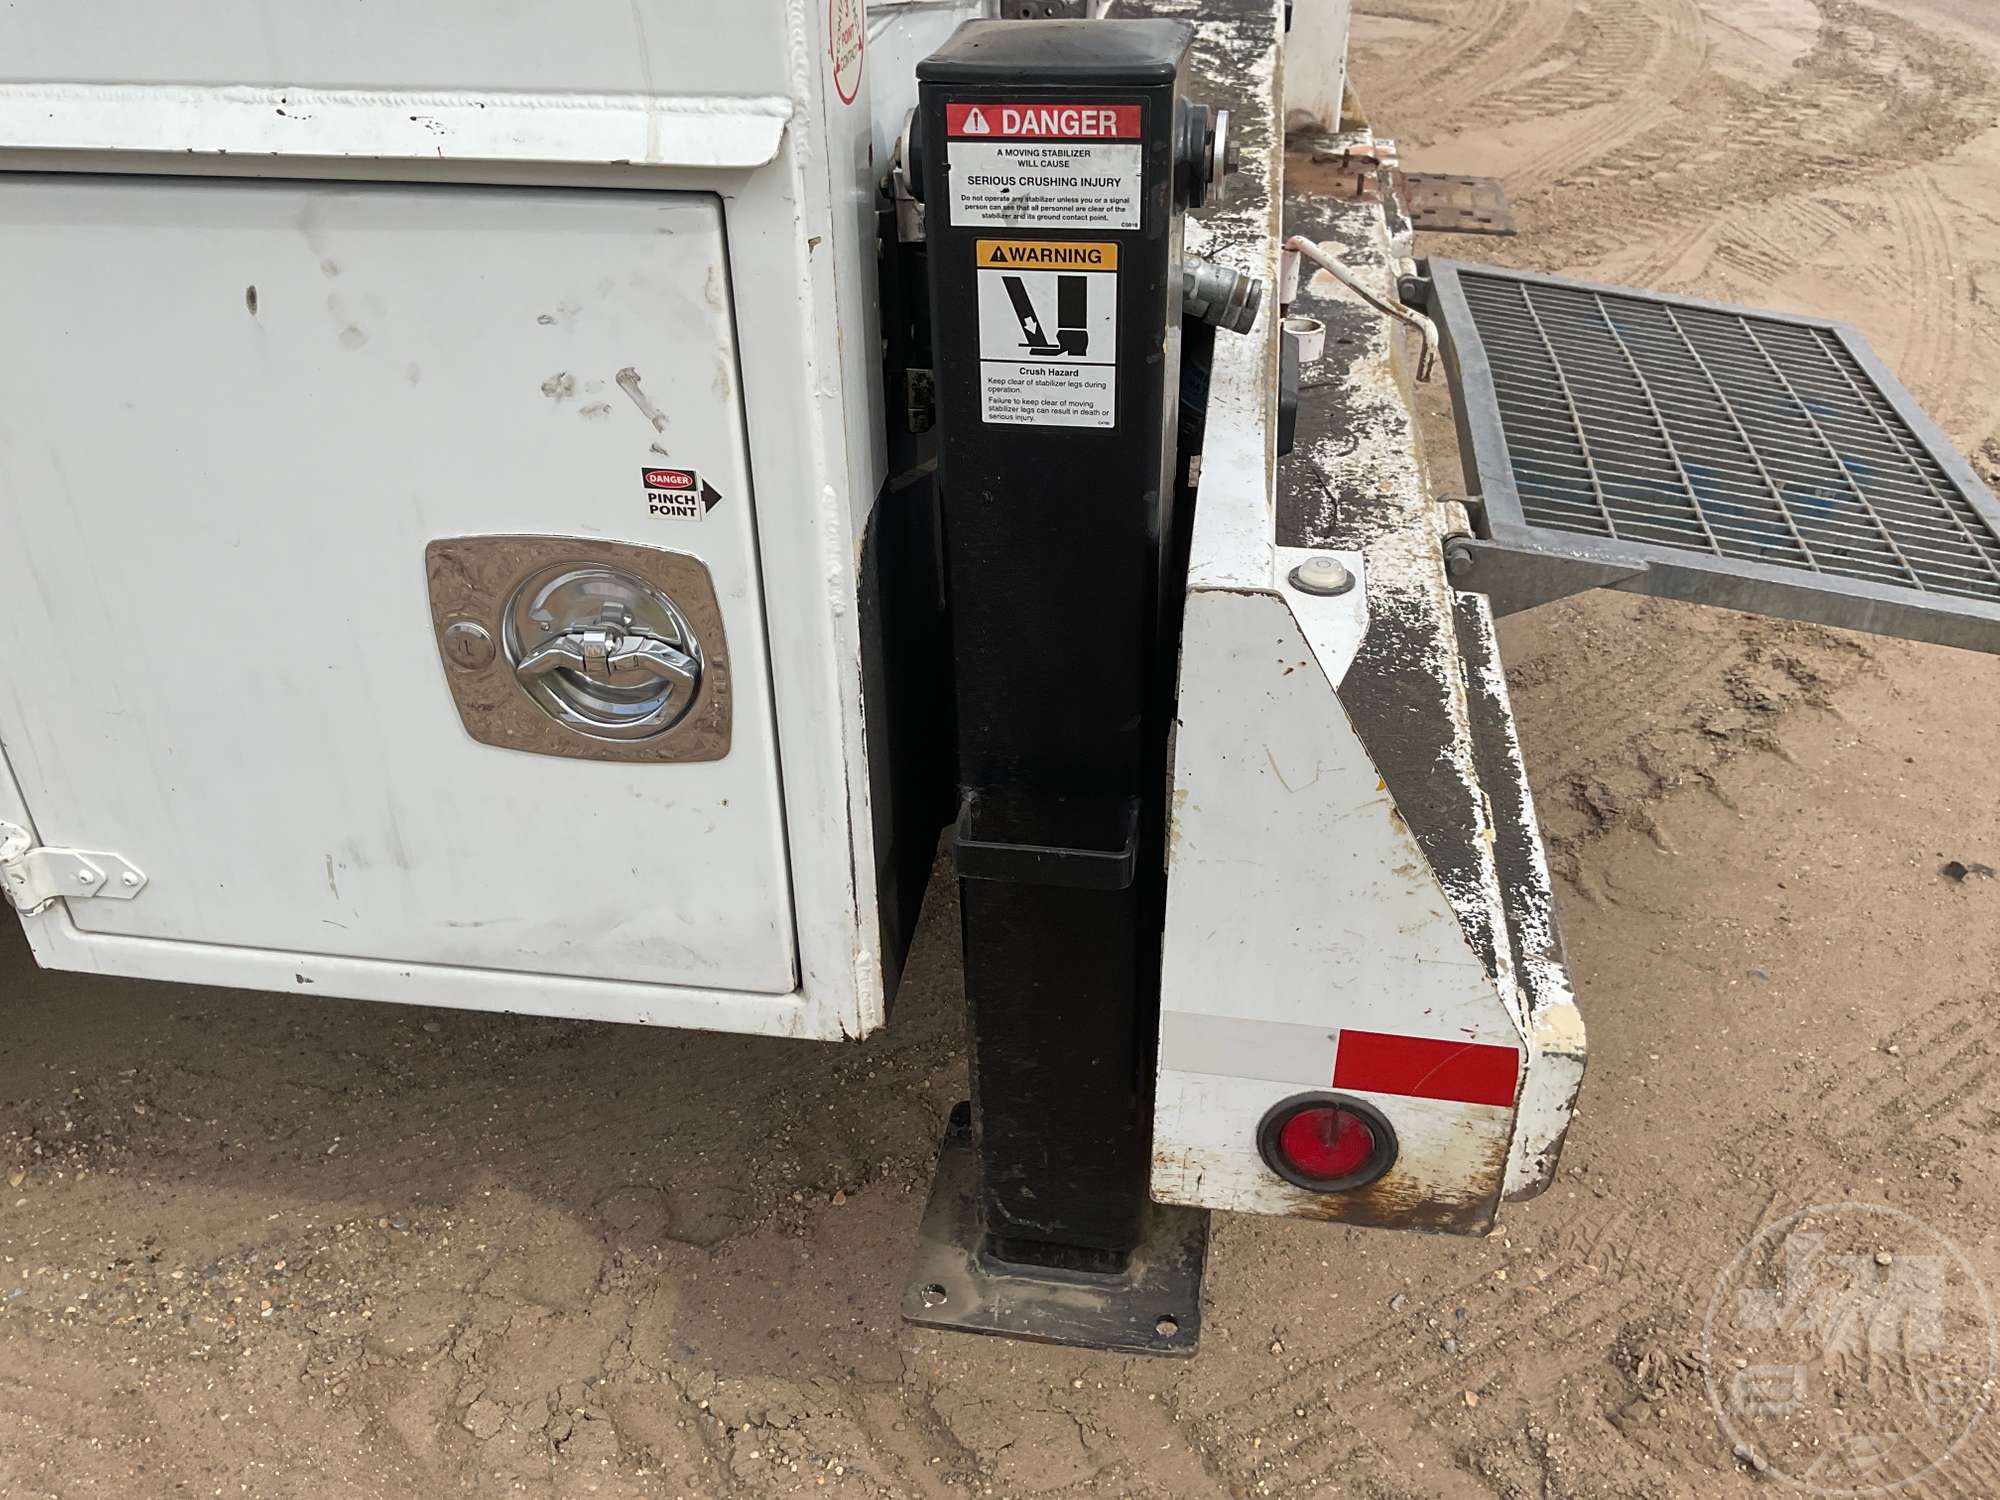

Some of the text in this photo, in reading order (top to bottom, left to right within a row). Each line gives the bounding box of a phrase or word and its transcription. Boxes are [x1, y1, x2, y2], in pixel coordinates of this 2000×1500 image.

[1002, 109, 1117, 136] DANGER
[1005, 149, 1039, 157] MOVING
[1042, 150, 1090, 158] STABILIZER
[967, 176, 1121, 187] SERIOUS CRUSHING INJURY
[1041, 205, 1073, 213] personnel
[1009, 247, 1102, 263] WARNING
[1019, 367, 1078, 377] Crush Hazard
[988, 377, 1006, 385] Keep
[1035, 379, 1066, 387] stabilizer
[1068, 381, 1082, 389] legs
[1084, 381, 1106, 389] during
[988, 386, 1021, 394] operation.
[1022, 398, 1038, 406] keep
[1069, 401, 1094, 409] moving
[1051, 407, 1070, 415] result
[1015, 414, 1035, 422] injury.
[650, 475, 689, 484] DANGER
[648, 493, 695, 505] PINCH
[650, 505, 697, 517] POINT
